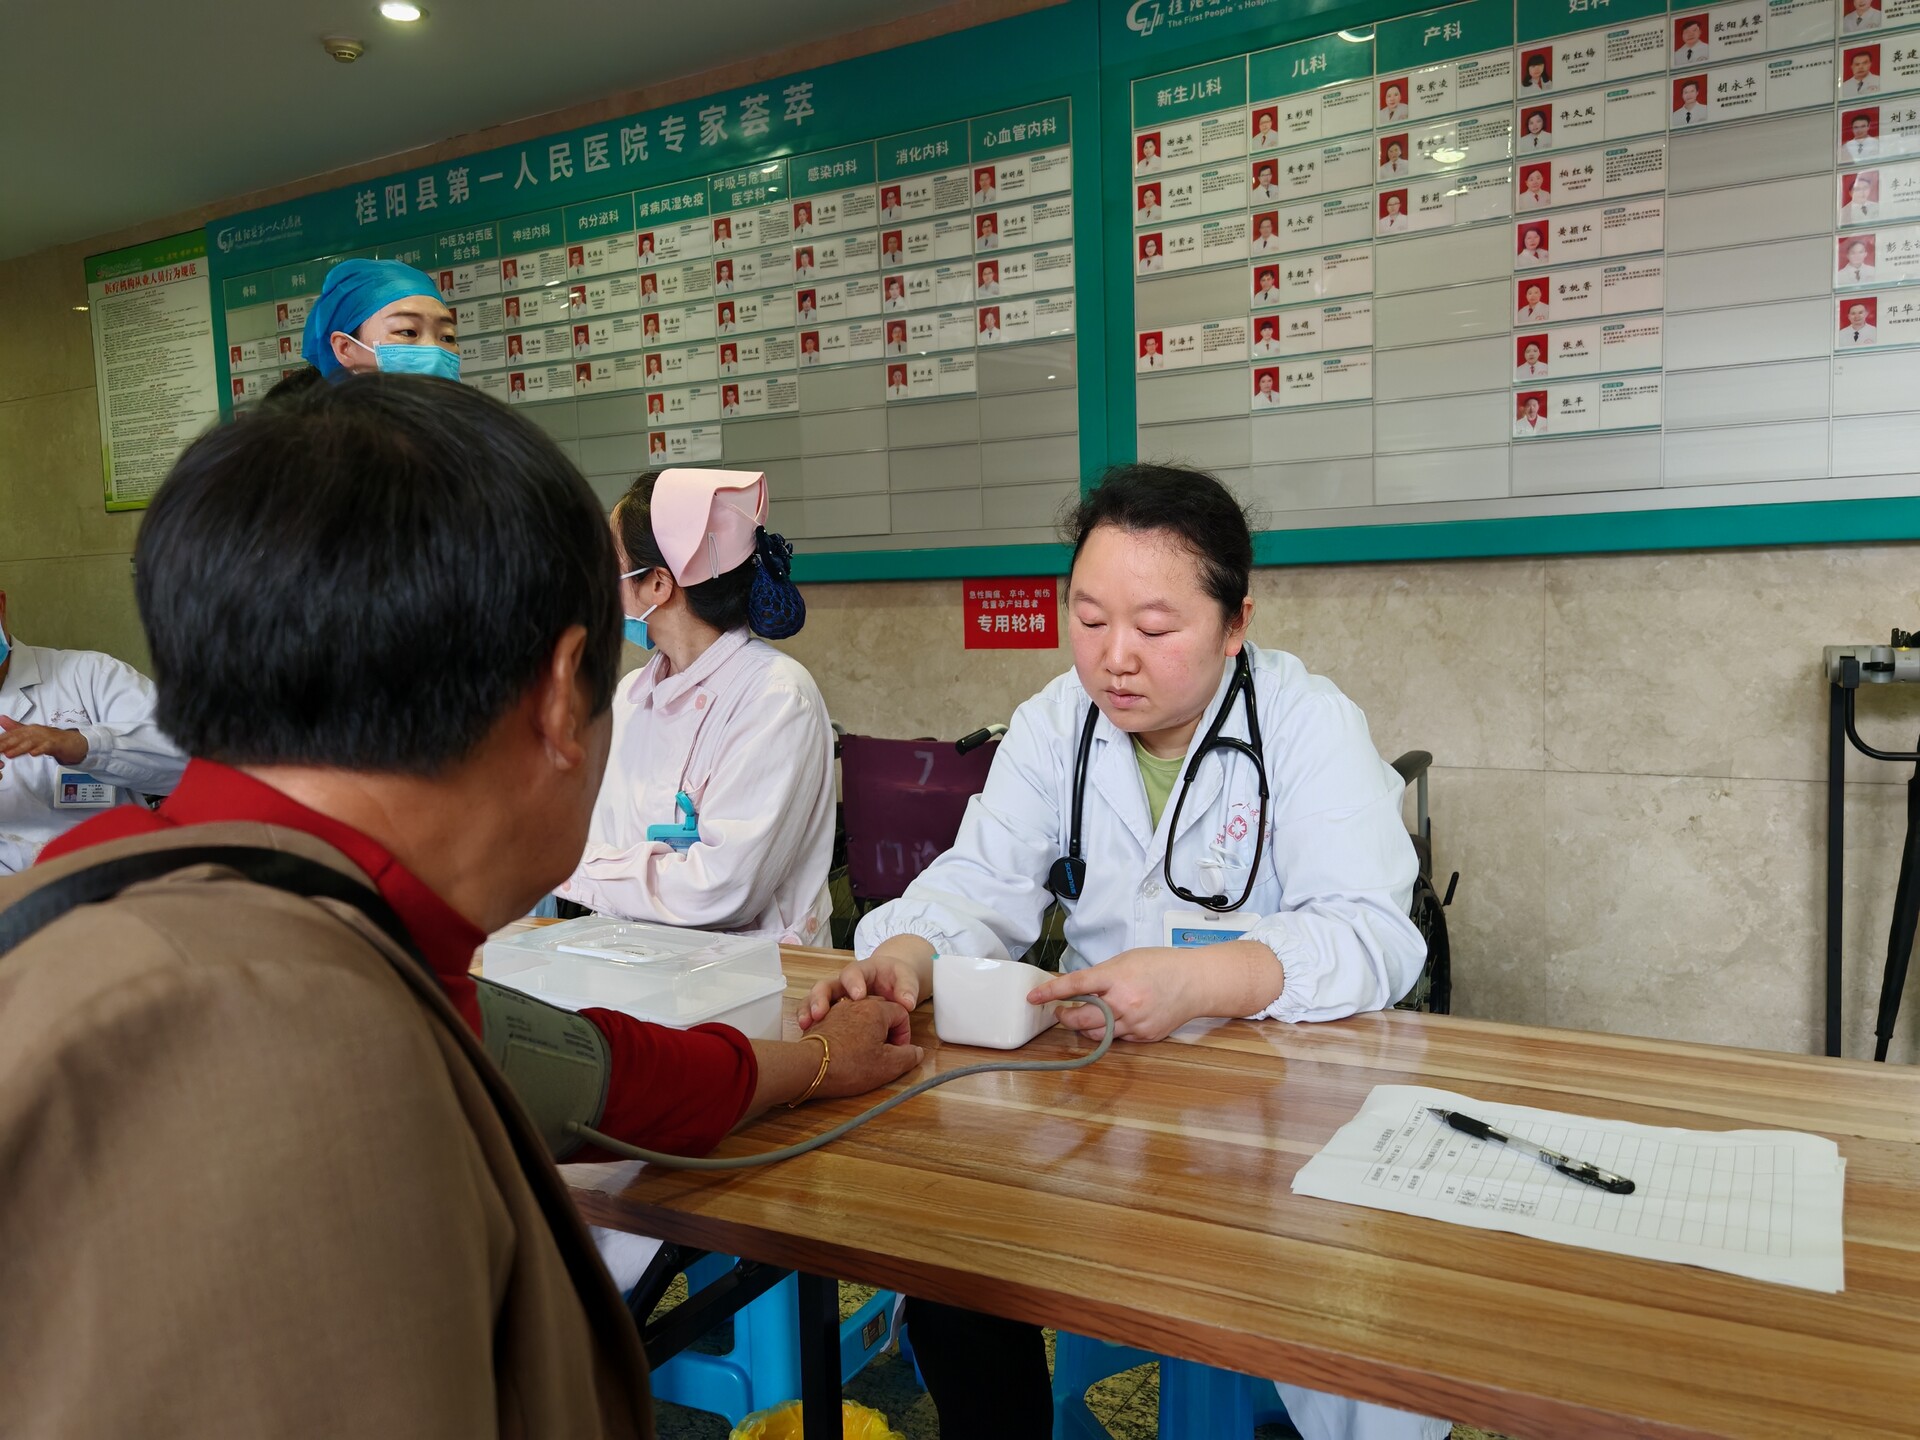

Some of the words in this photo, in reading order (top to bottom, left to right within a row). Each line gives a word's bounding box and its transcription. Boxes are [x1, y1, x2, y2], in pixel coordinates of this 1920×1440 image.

[1167, 19, 1182, 28] The
[1184, 13, 1202, 24] First
[1423, 21, 1462, 46] 产科
[1291, 53, 1327, 78] 儿科
[1157, 77, 1222, 107] 新生儿科
[1717, 76, 1756, 93] 胡永华
[983, 117, 1056, 148] 心血管内科
[355, 82, 815, 226] 桂阳县第一人民医院专家荟萃
[896, 141, 949, 165] 消化内科
[807, 160, 858, 182] 感染内科
[1890, 178, 1920, 191] 李小
[639, 192, 704, 217] 肾病风湿免疫
[731, 187, 766, 207] 医学科
[578, 209, 620, 230] 内分泌科
[439, 227, 494, 249] 中医及中西医
[512, 224, 551, 241] 神经内科
[453, 245, 481, 260] 结合科
[104, 262, 197, 295] 医疗机构从业人员行为规范
[1887, 303, 1920, 317] 邓华
[969, 589, 1050, 599] 急性胸痛、卒中、创伤
[977, 613, 1046, 633] 专用轮椅
[914, 750, 935, 786] 7
